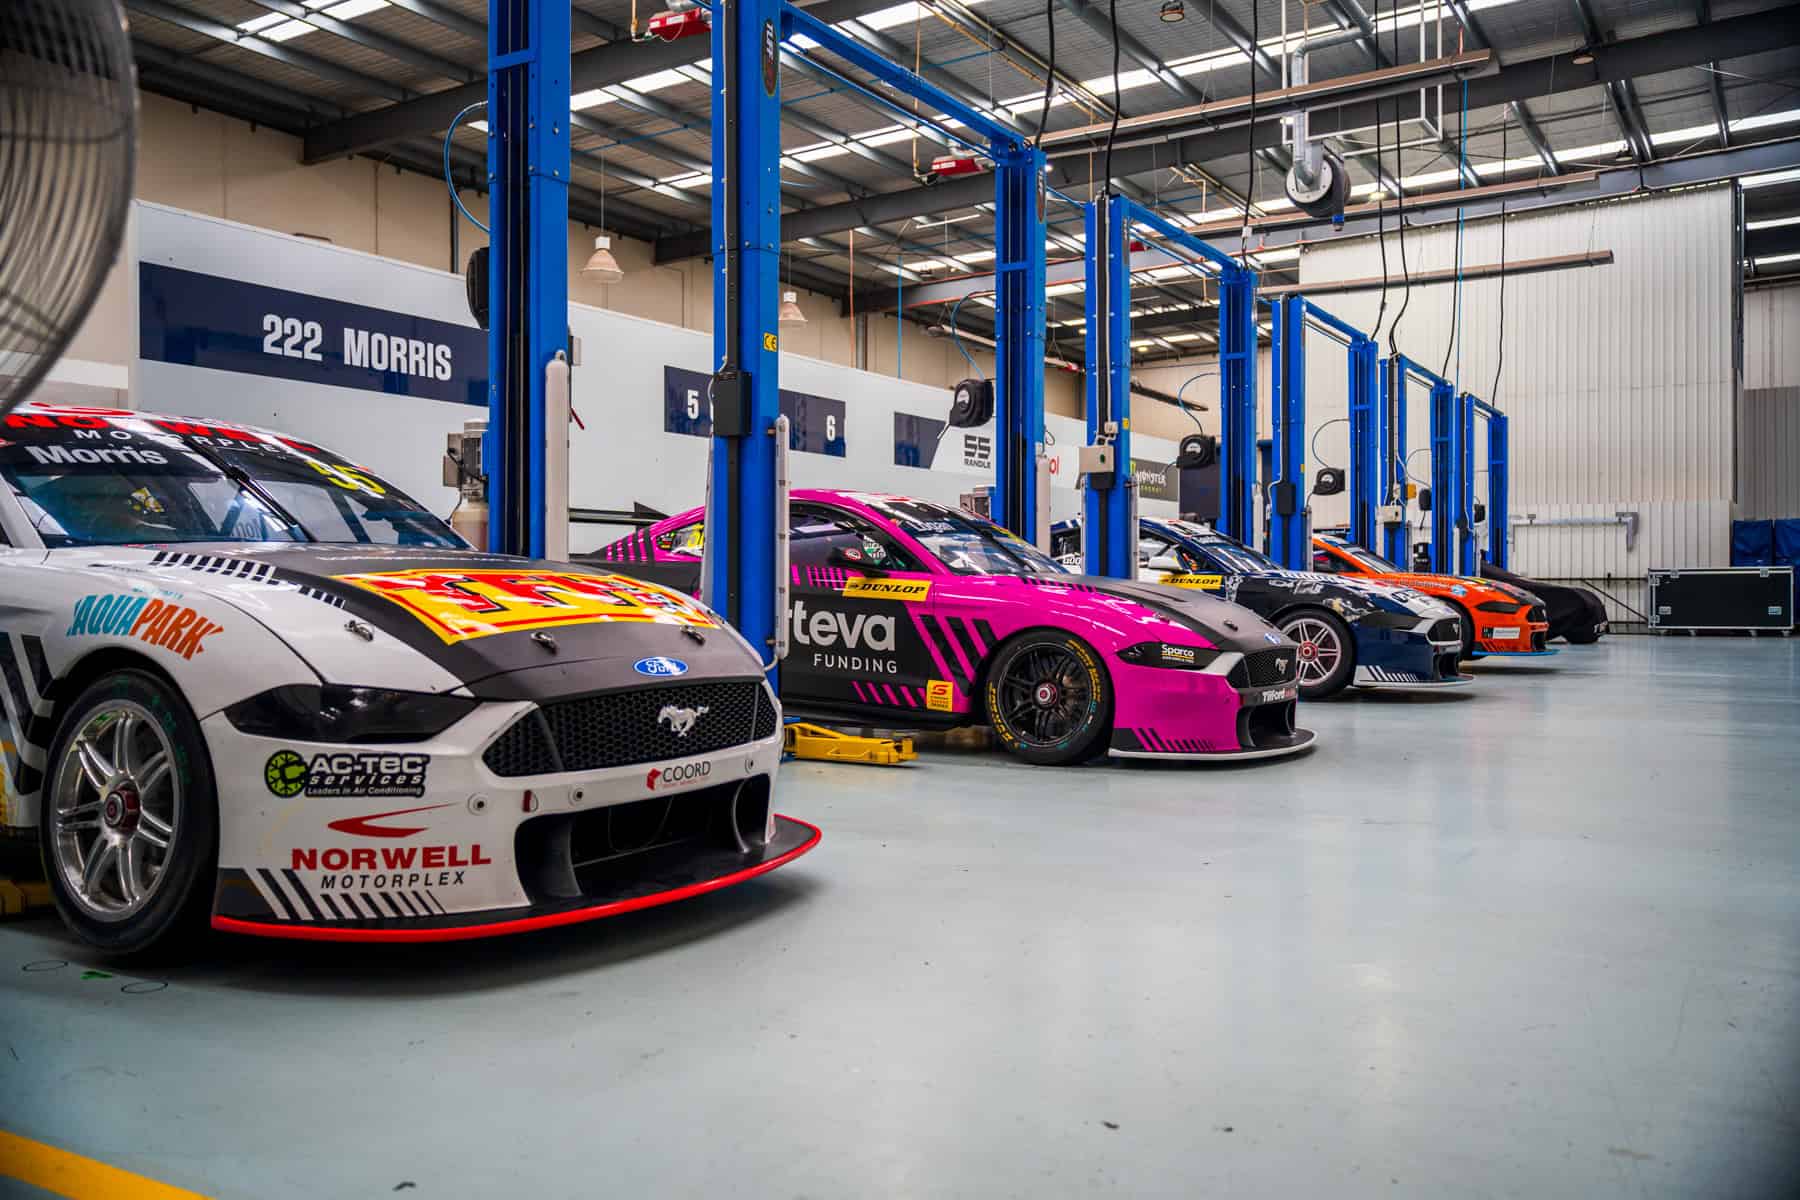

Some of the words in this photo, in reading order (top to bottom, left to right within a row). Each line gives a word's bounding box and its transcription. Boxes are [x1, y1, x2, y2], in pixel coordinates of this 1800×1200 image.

[263, 314, 323, 362] 222
[344, 327, 451, 381] MORRIS
[826, 415, 836, 442] 6
[25, 445, 169, 465] Morris
[964, 458, 991, 469] RANDLE
[859, 582, 926, 594] DUNLOP
[1169, 576, 1220, 585] DUNLOP
[788, 600, 896, 651] teva
[1161, 644, 1195, 657] Sparco
[813, 653, 898, 674] FUNDING
[309, 773, 422, 784] services
[662, 761, 712, 783] COORD
[307, 786, 340, 795] Leaders
[342, 786, 351, 795] in
[353, 786, 366, 795] Air
[368, 786, 422, 796] Conditioning
[291, 844, 492, 870] NORWELL
[321, 871, 466, 889] MOTORPLEX
